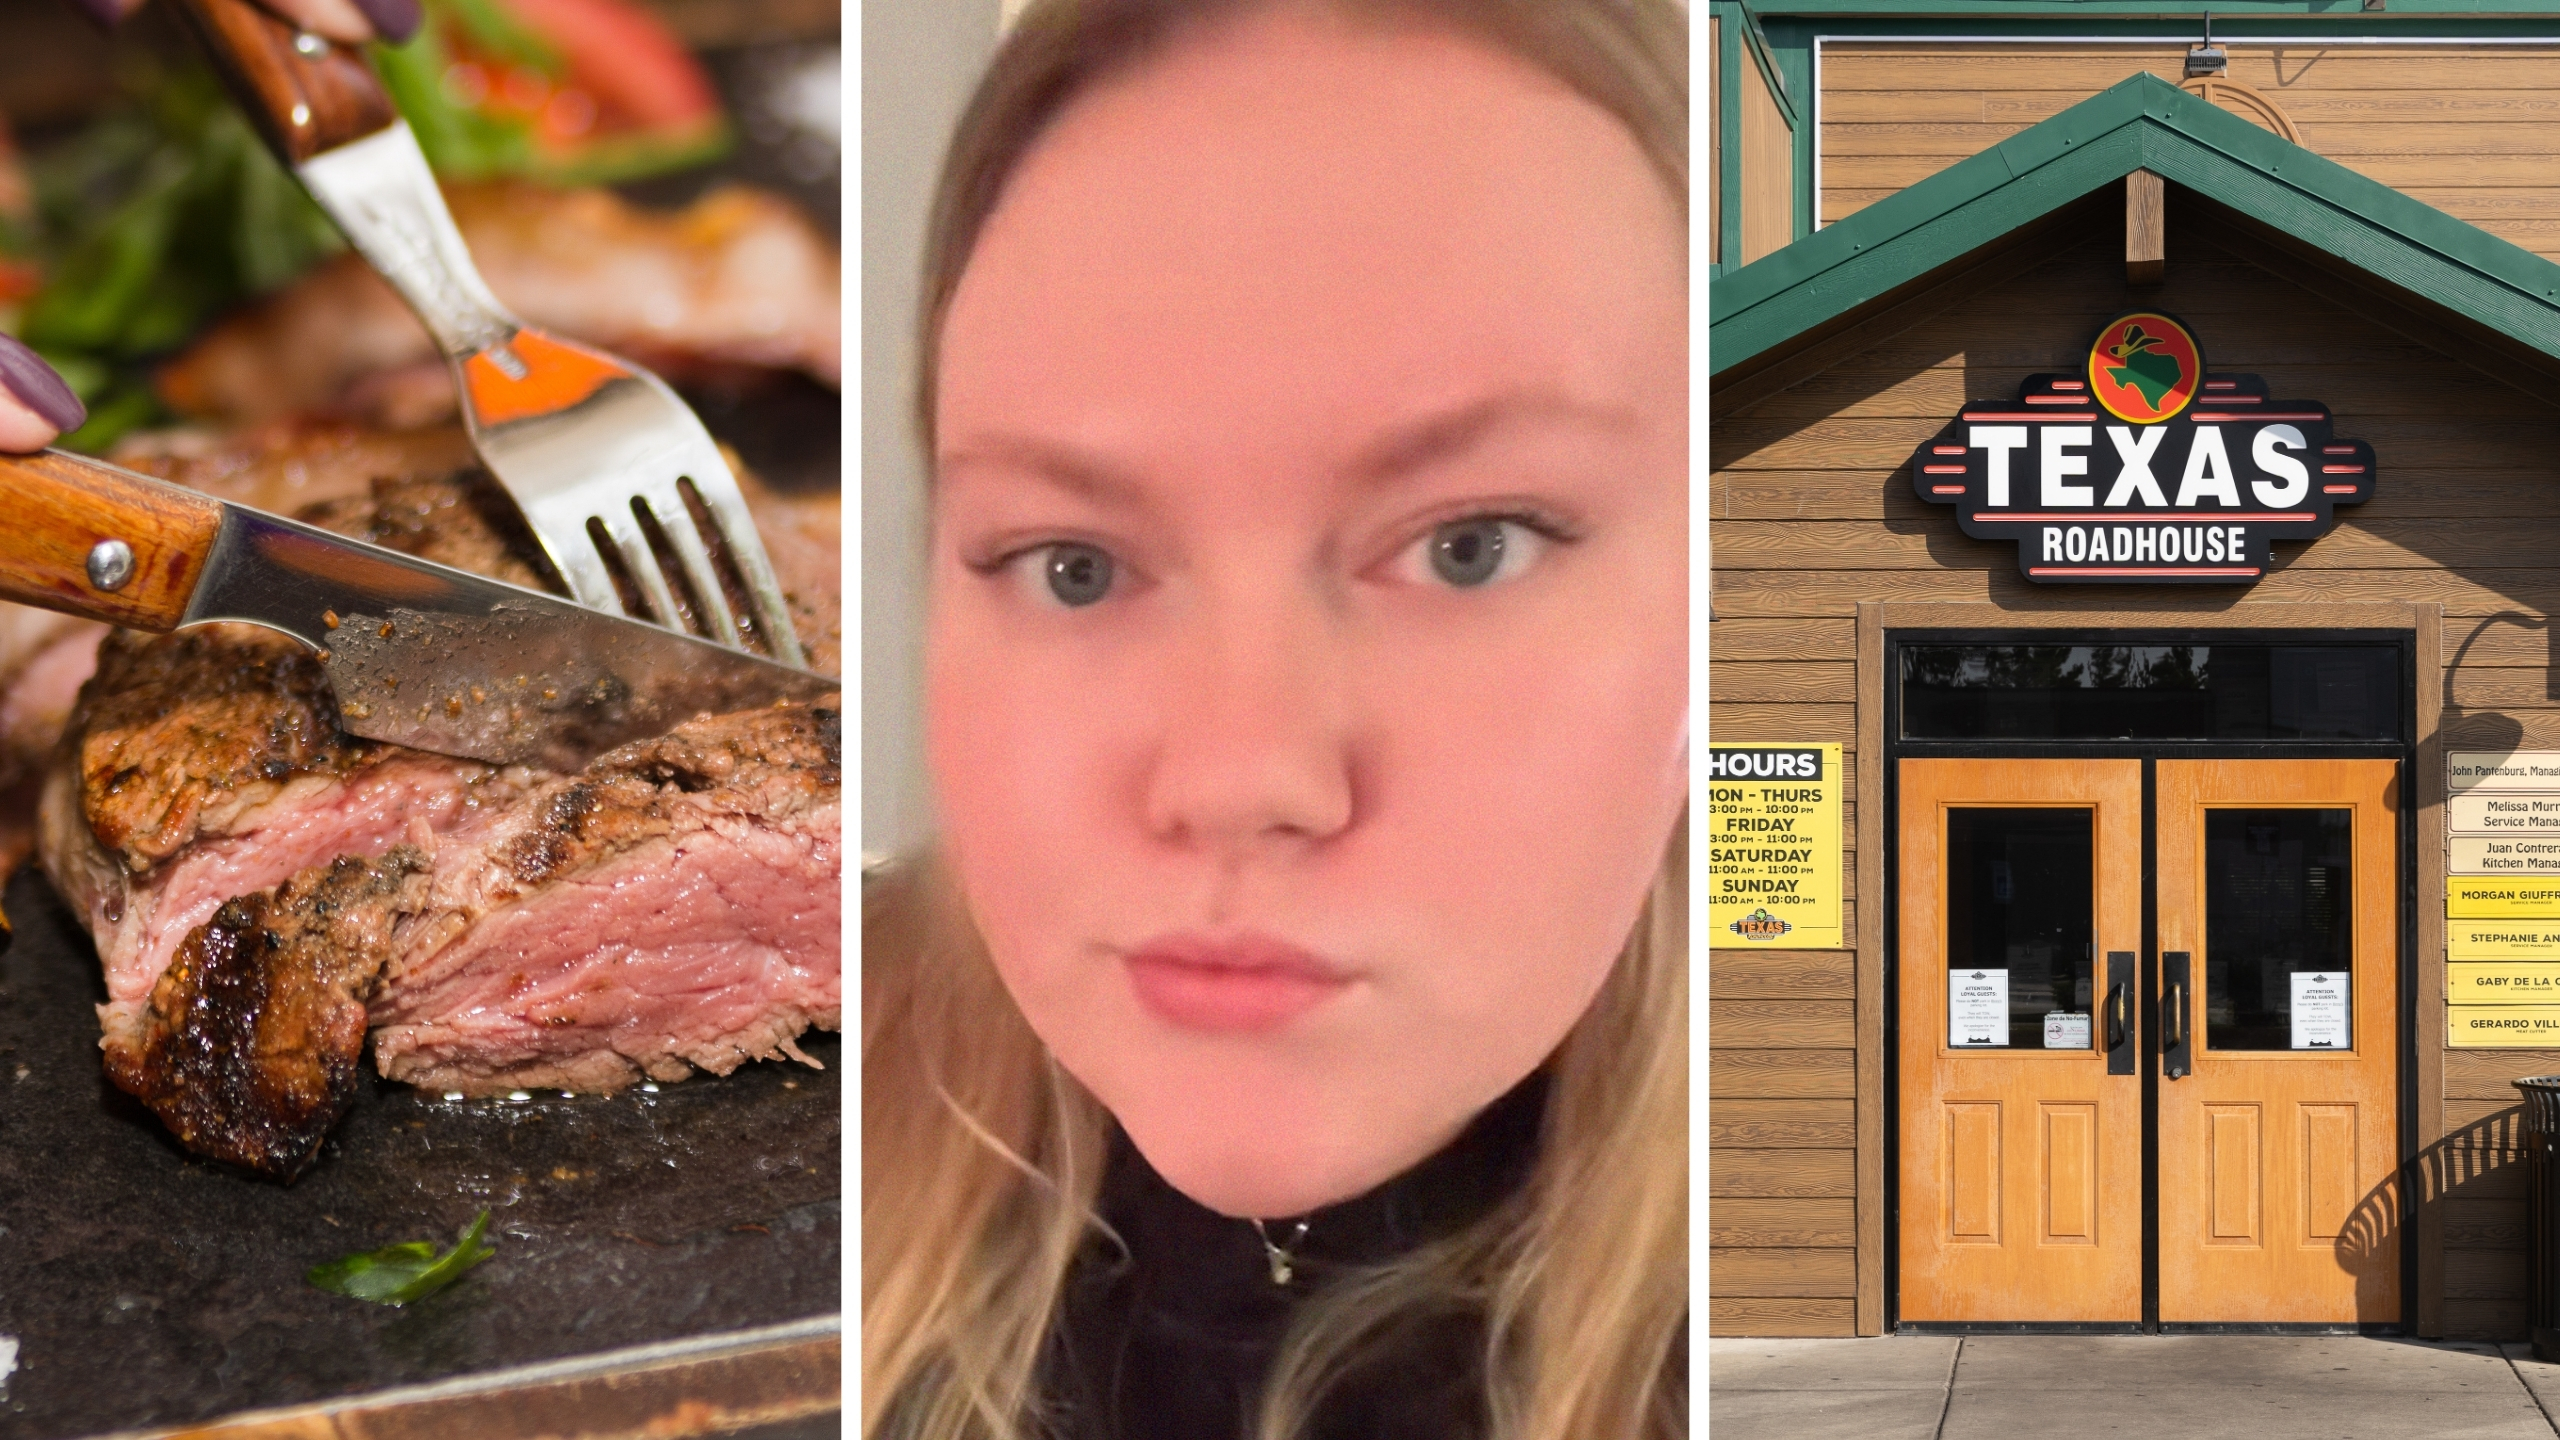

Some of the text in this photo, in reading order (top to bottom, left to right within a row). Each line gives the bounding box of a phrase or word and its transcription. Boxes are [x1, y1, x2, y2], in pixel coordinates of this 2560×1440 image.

[1969, 423, 2310, 508] TEXAS
[2042, 526, 2245, 562] ROADHOUSE
[1709, 753, 1816, 777] HOURS
[2452, 765, 2472, 776] John
[1761, 789, 1823, 802] THURS
[1709, 805, 1737, 814] 3:00
[1765, 805, 1799, 814] 10:00
[2488, 801, 2528, 812] Melissa
[1727, 818, 1795, 831] FRIDAY
[2484, 816, 2525, 827] Service
[1710, 834, 1737, 843] 3:00
[1767, 834, 1797, 843] 11:00
[2487, 843, 2512, 854] Juan
[1710, 849, 1812, 862] SATURDAY
[2482, 857, 2523, 869] Kitchen
[1709, 865, 1738, 874] 11:00
[1768, 865, 1798, 874] 11:00
[1722, 879, 1799, 892] SUNDAY
[1767, 895, 1800, 904] 10:00
[2461, 890, 2560, 900] MORGAN GIUFFR
[1739, 921, 1784, 934] TEXAS
[2471, 933, 2560, 943] STEPHANIE AN
[2476, 977, 2509, 986] GABY
[2514, 977, 2530, 986] DE
[2534, 977, 2550, 986] LA
[2470, 1019, 2560, 1029] GERARDO VILL
